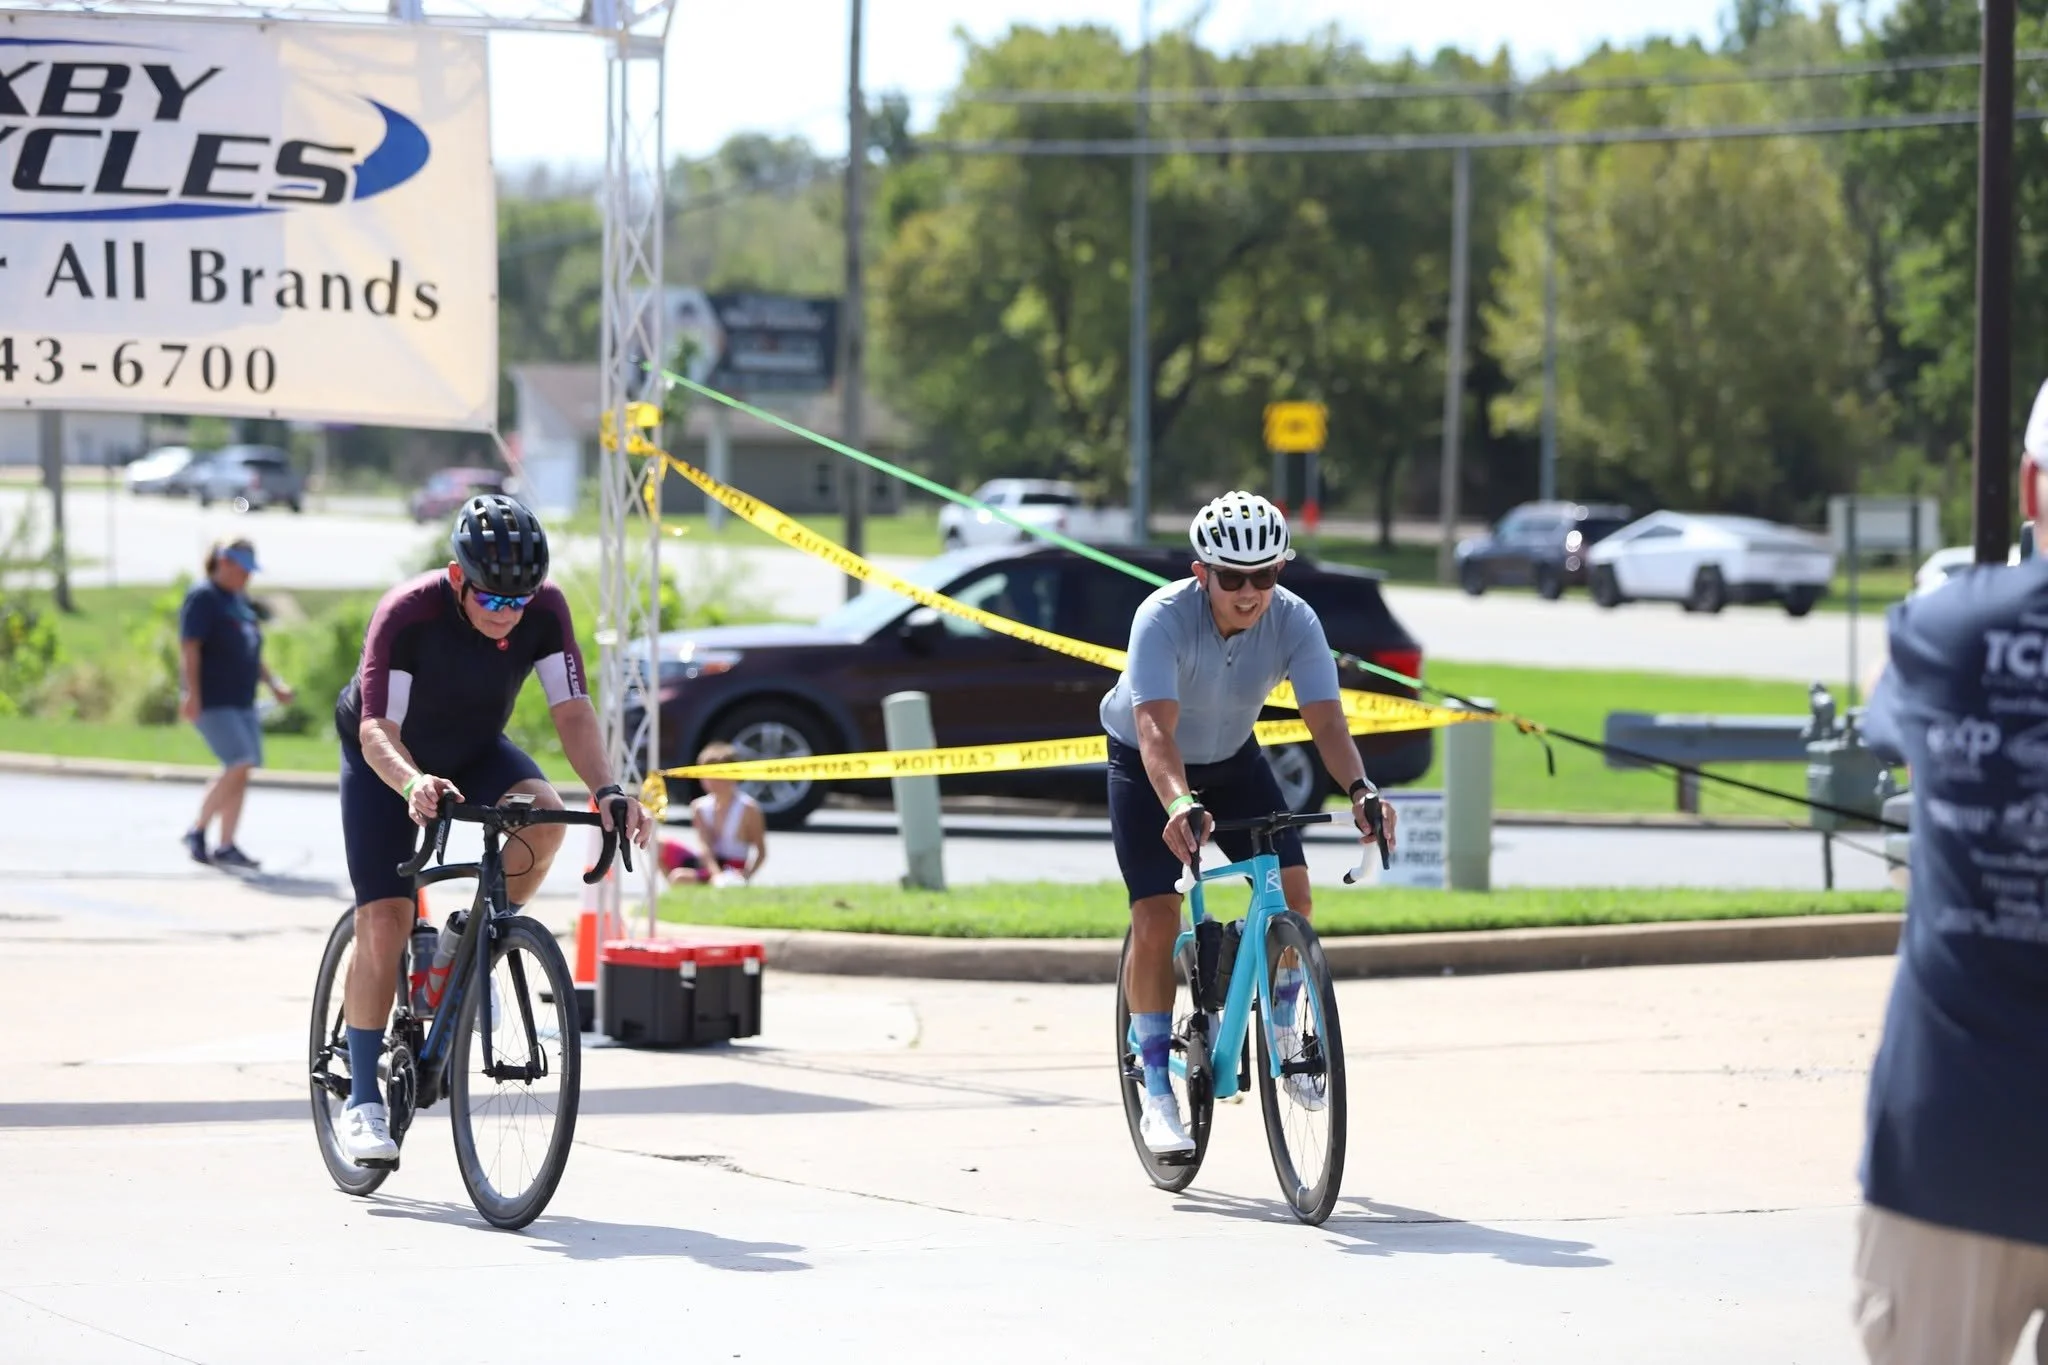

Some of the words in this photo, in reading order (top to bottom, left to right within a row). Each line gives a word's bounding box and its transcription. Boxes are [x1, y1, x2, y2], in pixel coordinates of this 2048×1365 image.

[0, 125, 355, 205] CLES
[46, 240, 146, 300] All
[190, 249, 441, 321] Brands
[777, 521, 871, 578] CAUTION
[1983, 629, 2048, 678] TC
